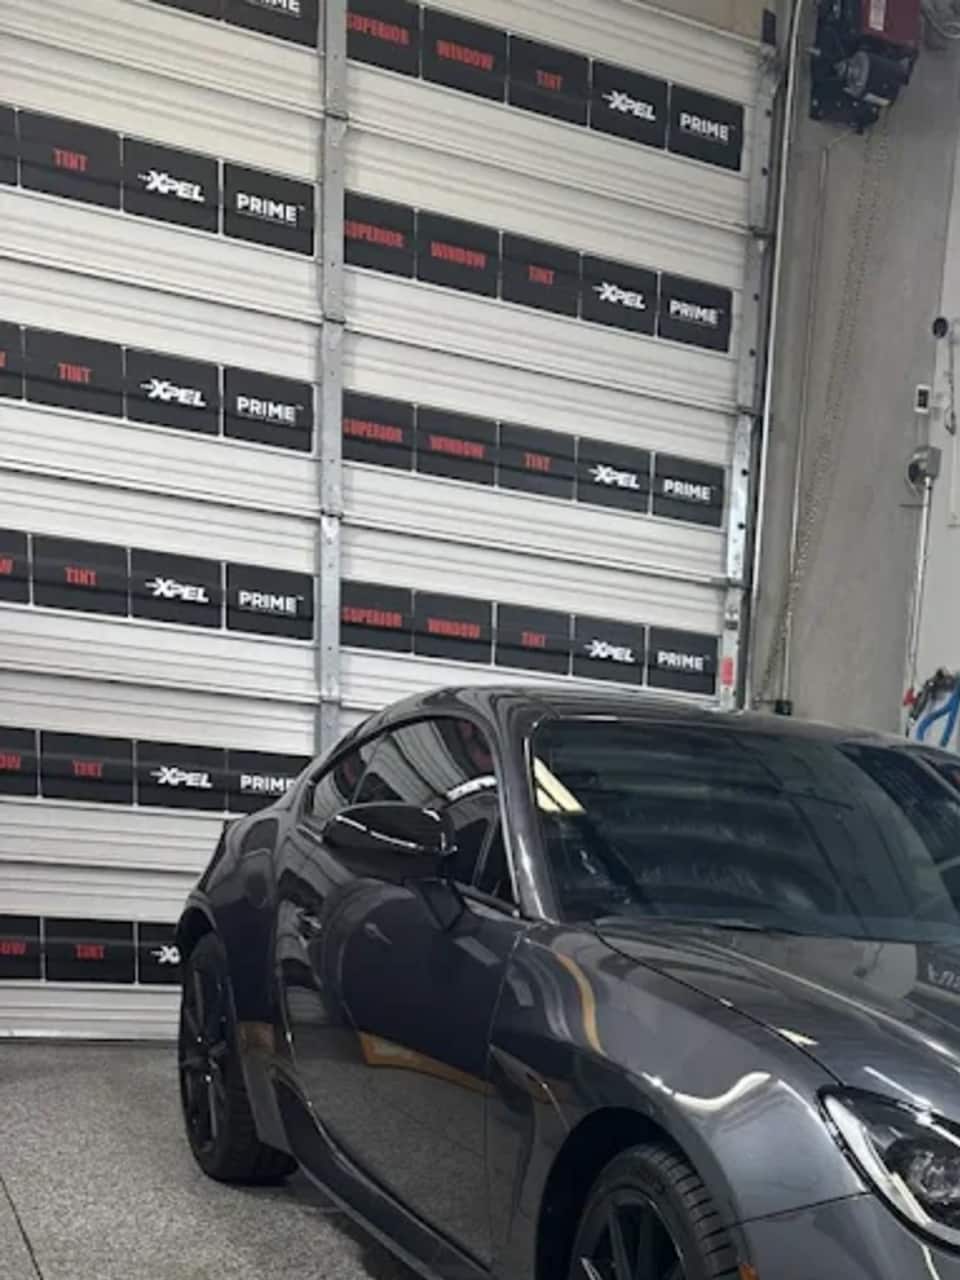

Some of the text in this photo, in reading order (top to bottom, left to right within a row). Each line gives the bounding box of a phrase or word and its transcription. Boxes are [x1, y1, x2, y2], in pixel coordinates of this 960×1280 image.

[536, 69, 563, 89] TINT
[607, 90, 656, 121] XPEL
[680, 112, 729, 141] PRIME
[54, 148, 297, 222] TINT XPEL PRIME
[529, 265, 555, 285] TINT
[600, 281, 646, 310] XPEL
[669, 299, 718, 325] PRIME
[58, 362, 296, 421] TINT XPEL PRIME
[525, 453, 551, 472] TINT
[595, 464, 640, 490] XPEL
[663, 479, 711, 501] PRIME
[65, 566, 297, 614] TINT XPEL PRIME
[521, 632, 546, 648] TINT
[590, 640, 635, 663] XPEL
[657, 650, 704, 671] PRIME
[73, 759, 103, 778] TINT
[158, 766, 213, 789] XPEL
